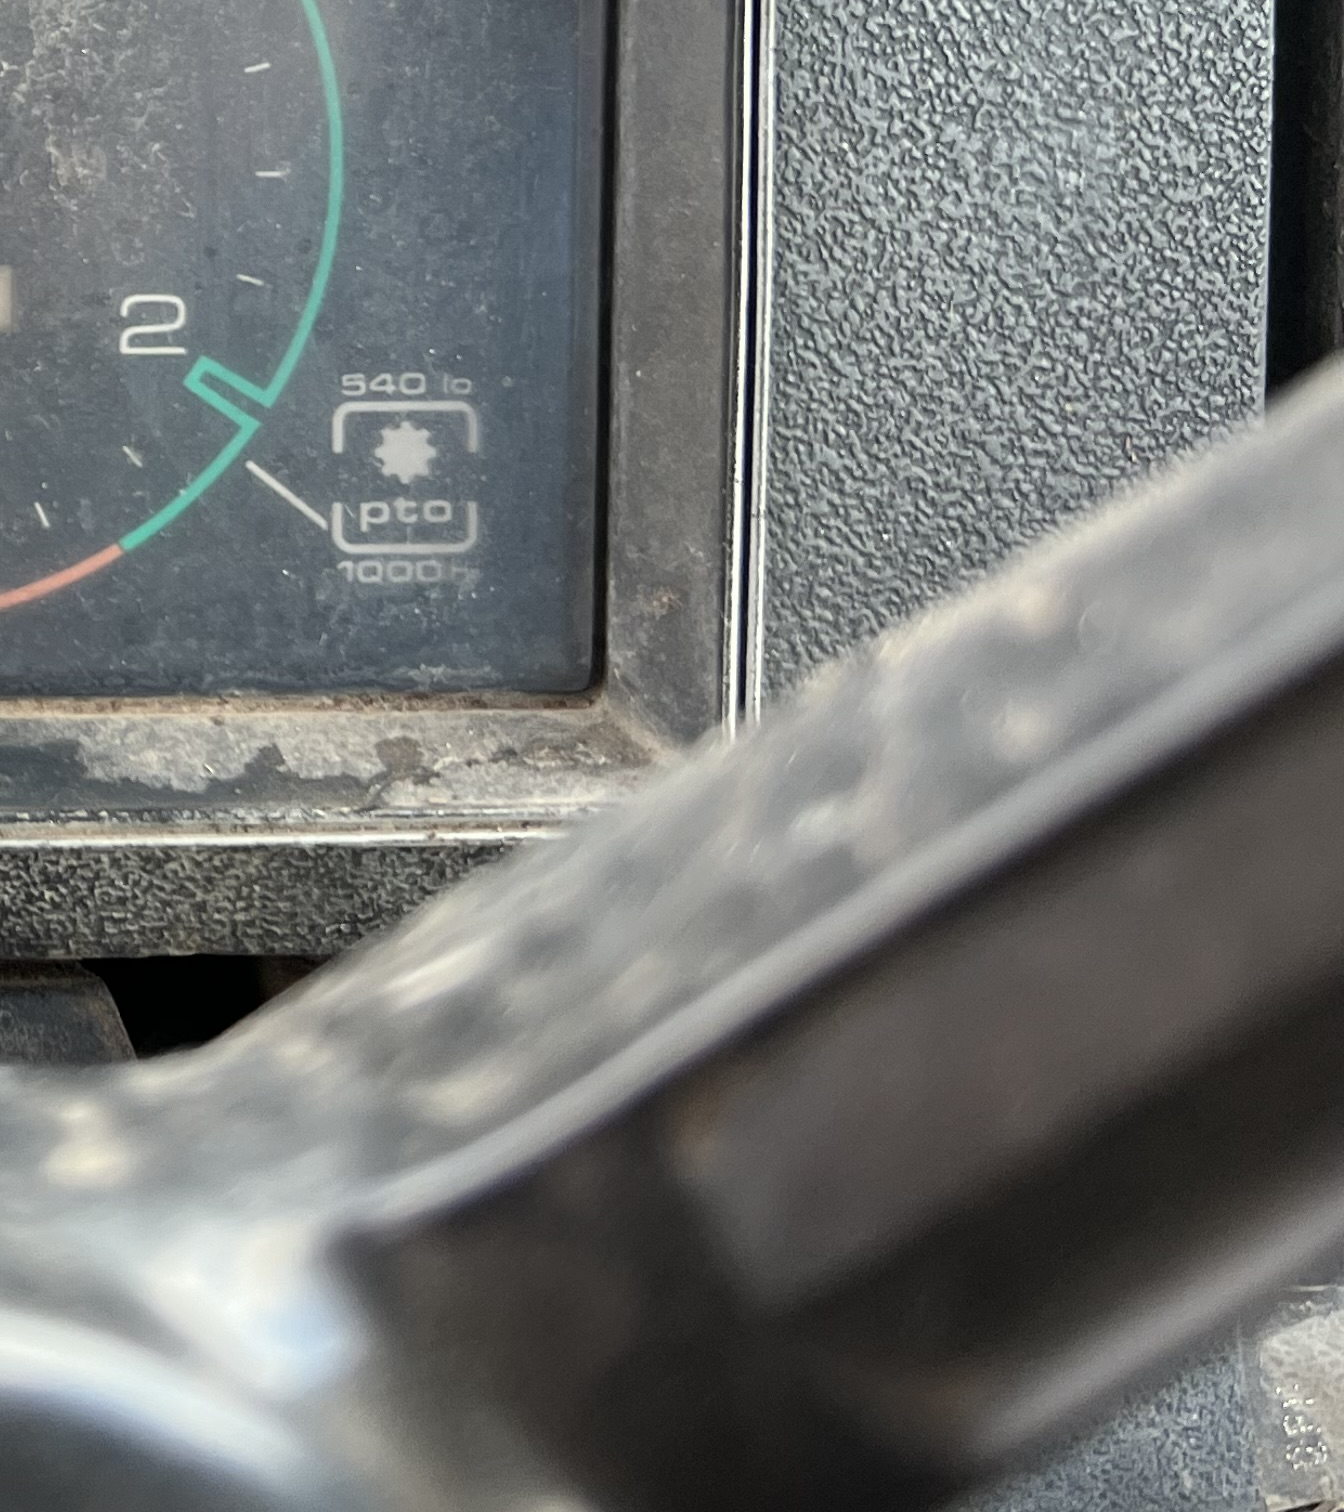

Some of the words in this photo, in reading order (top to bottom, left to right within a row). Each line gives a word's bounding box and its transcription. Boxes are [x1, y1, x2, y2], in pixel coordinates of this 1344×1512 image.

[119, 294, 187, 355] 2
[341, 372, 426, 396] 540
[360, 497, 452, 532] pto
[336, 560, 441, 583] 1000
